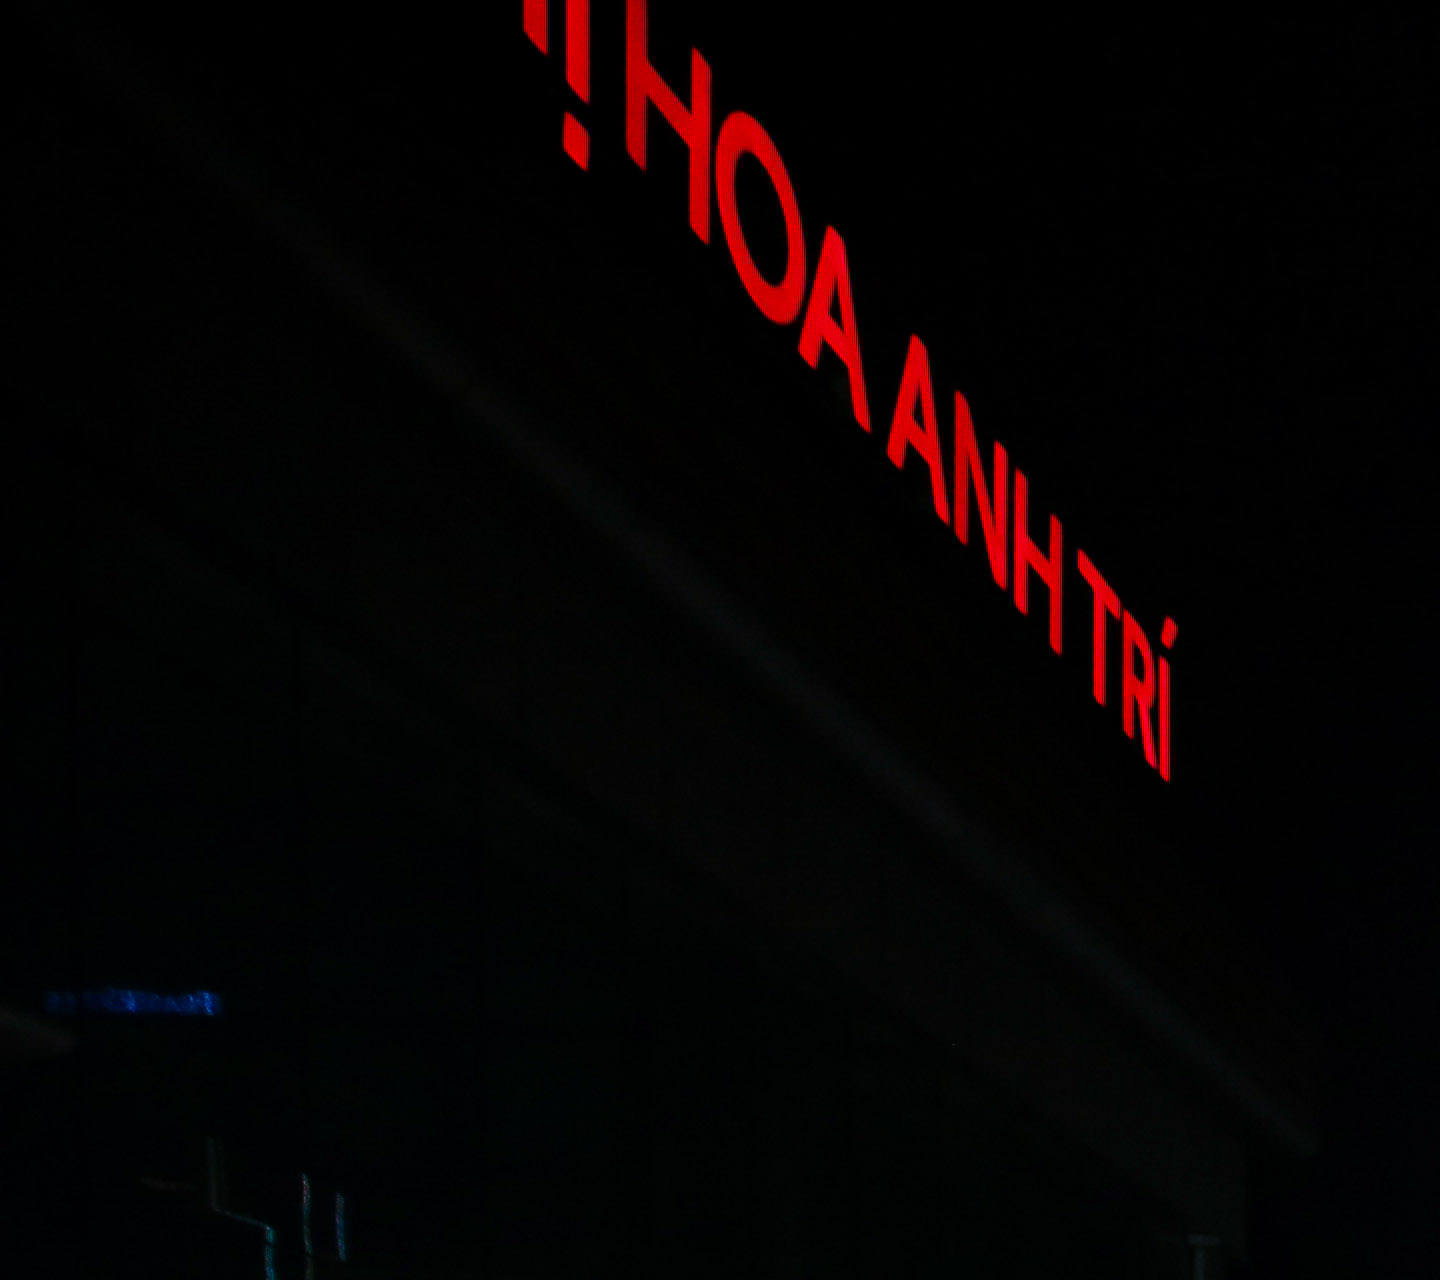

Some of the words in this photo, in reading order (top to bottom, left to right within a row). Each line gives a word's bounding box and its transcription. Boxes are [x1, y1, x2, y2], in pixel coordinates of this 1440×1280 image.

[625, 0, 871, 433] HOA
[887, 333, 1063, 656] ANH
[1077, 548, 1179, 783] TRÍ
